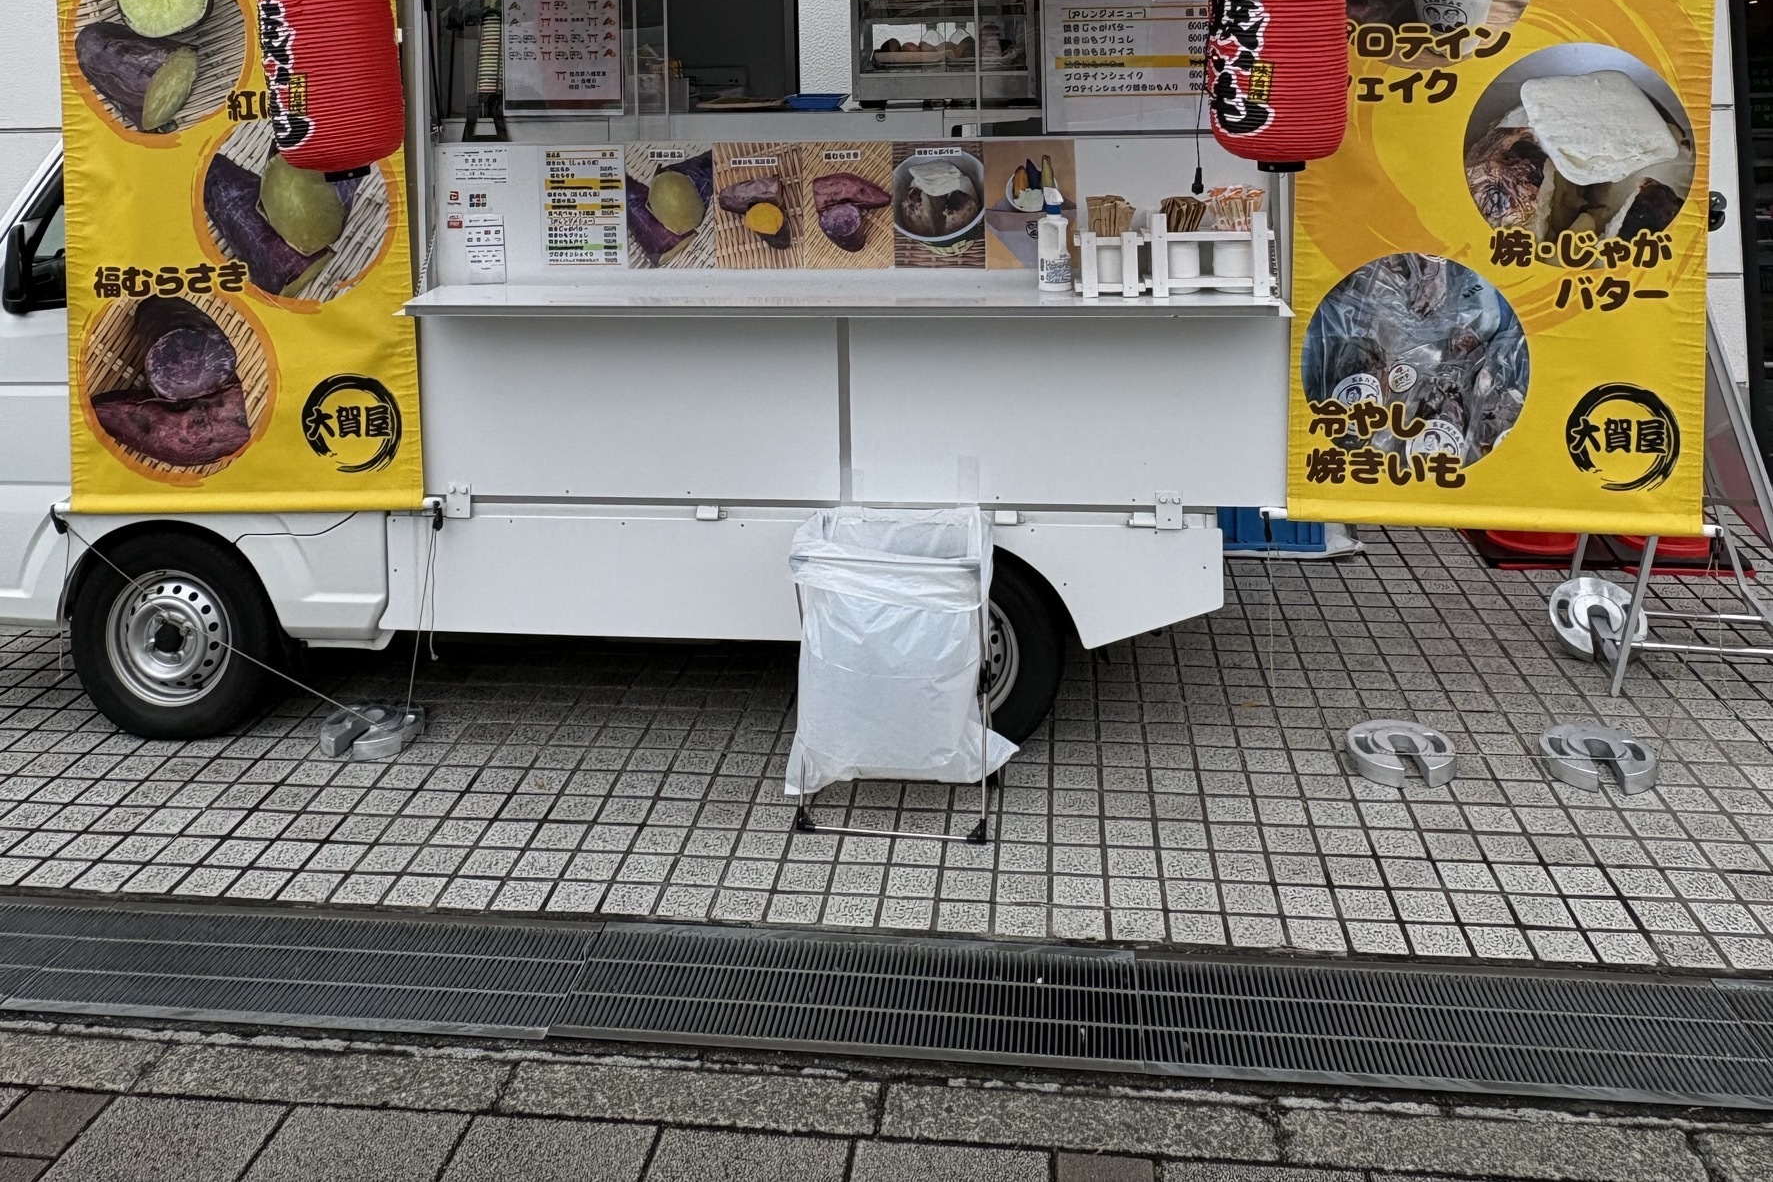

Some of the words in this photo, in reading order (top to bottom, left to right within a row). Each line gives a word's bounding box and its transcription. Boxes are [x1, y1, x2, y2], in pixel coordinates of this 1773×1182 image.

[1348, 70, 1458, 104] ェイク
[1490, 230, 1672, 268] 焼・じゃが
[94, 262, 247, 299] 福むらさき
[1555, 276, 1669, 312] バター
[306, 405, 392, 440] 大賀屋
[1309, 401, 1425, 438] 冷やし
[1570, 417, 1667, 454] 大賀屋
[1306, 448, 1466, 488] 焼きいも
